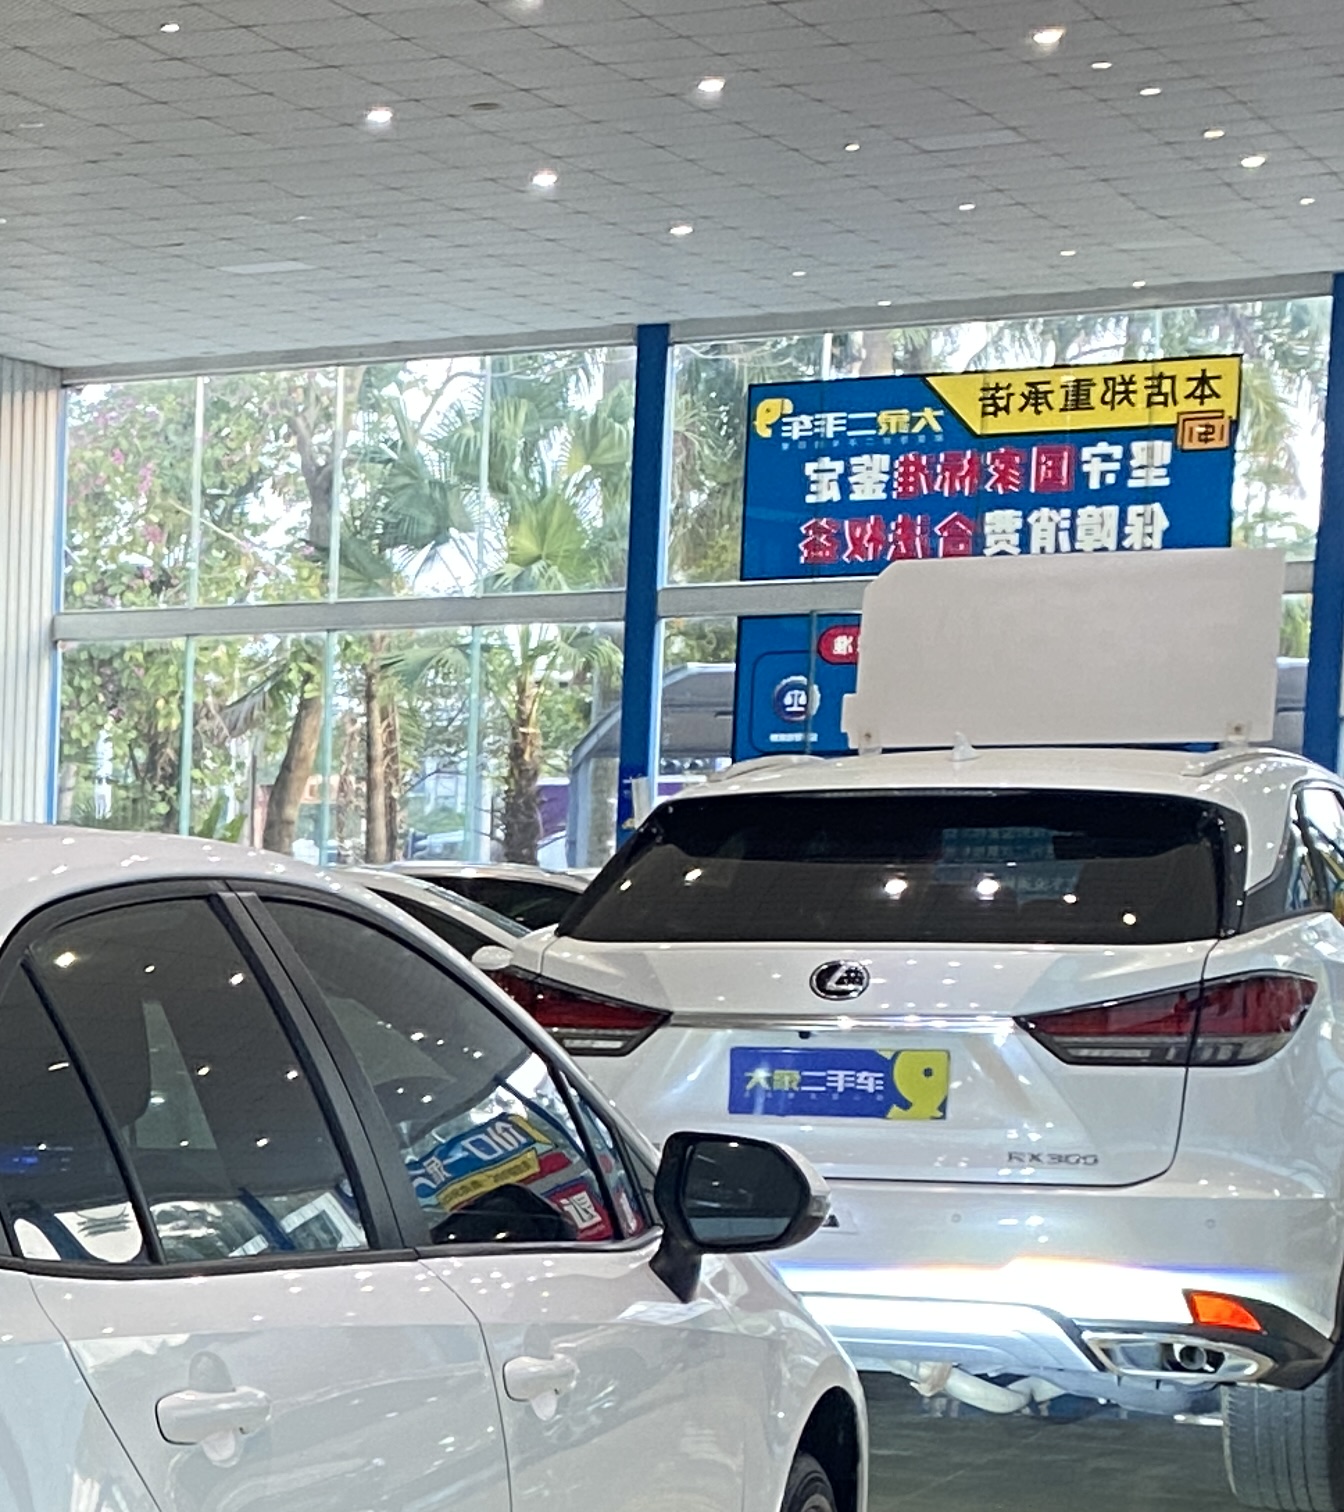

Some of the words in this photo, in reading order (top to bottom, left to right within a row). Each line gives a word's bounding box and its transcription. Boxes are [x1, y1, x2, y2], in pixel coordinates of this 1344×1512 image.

[743, 1067, 885, 1093] 大象二手车
